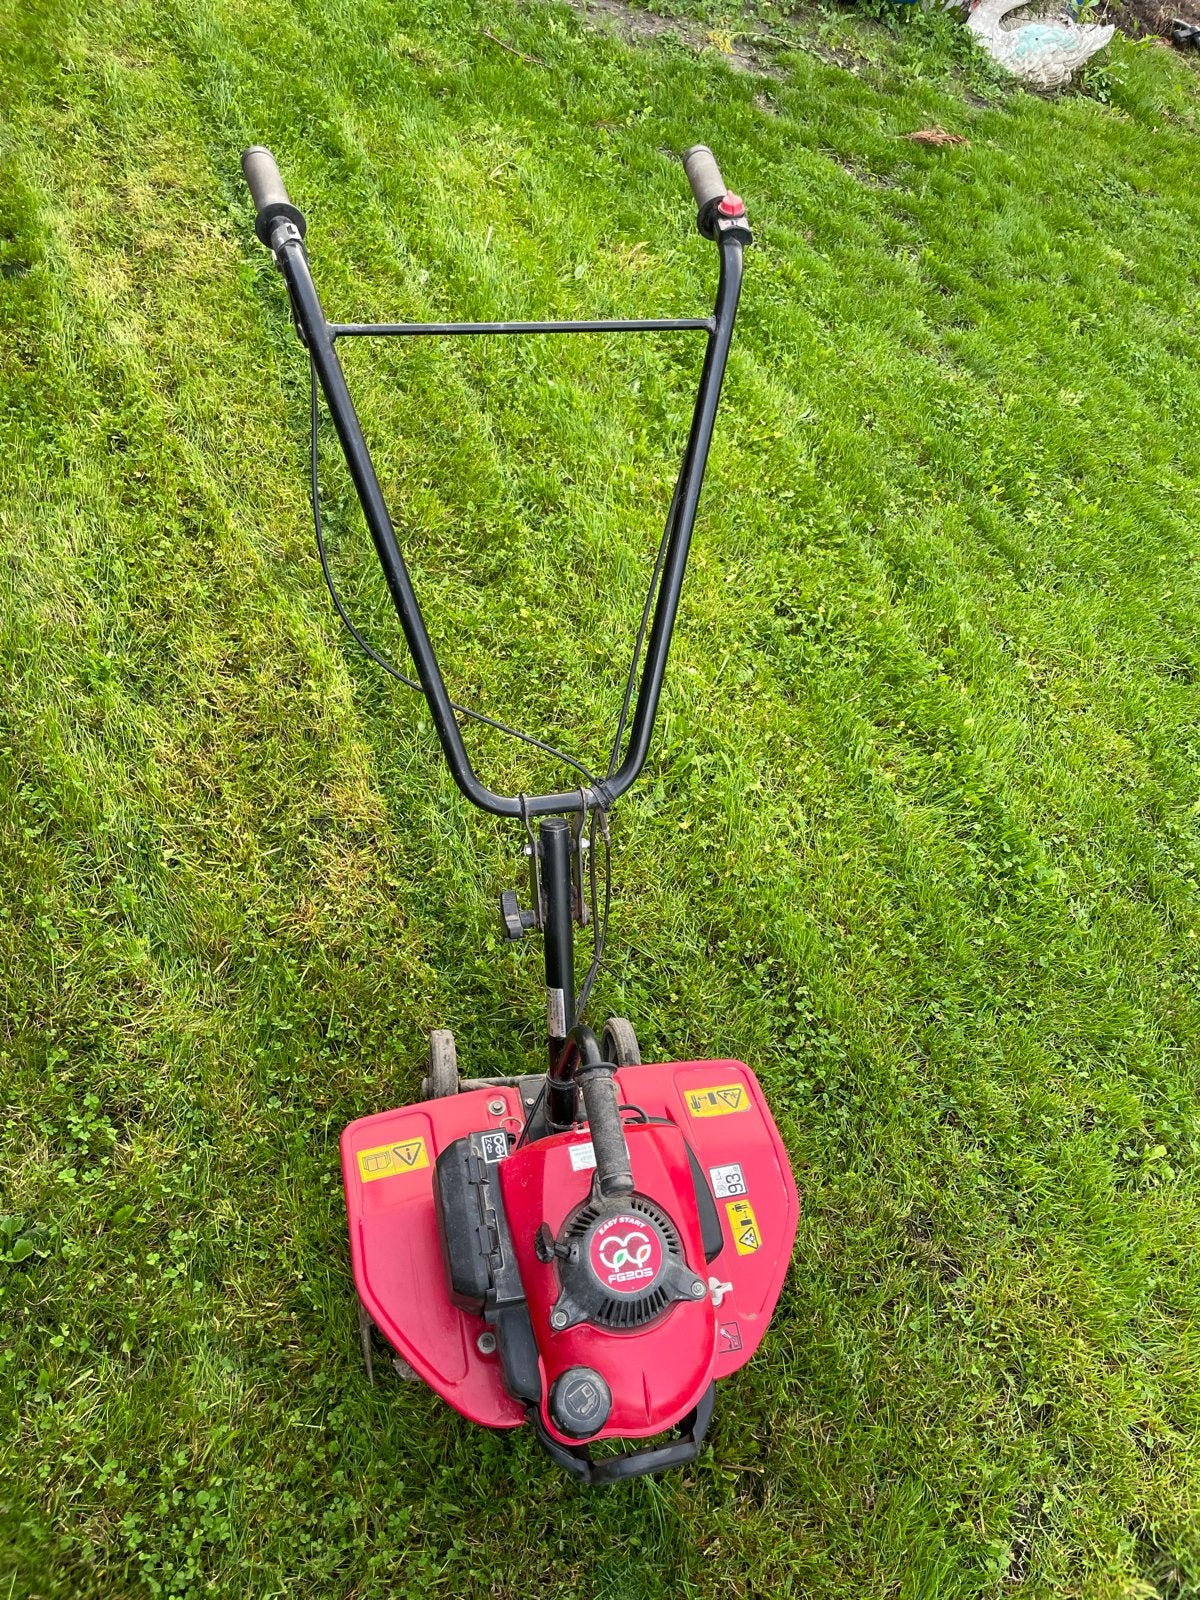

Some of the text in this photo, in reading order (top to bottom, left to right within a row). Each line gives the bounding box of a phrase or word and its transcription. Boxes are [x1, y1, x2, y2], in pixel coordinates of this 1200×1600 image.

[725, 1173, 744, 1194] 93
[598, 1216, 647, 1236] EASY START
[607, 1267, 654, 1284] FG205
